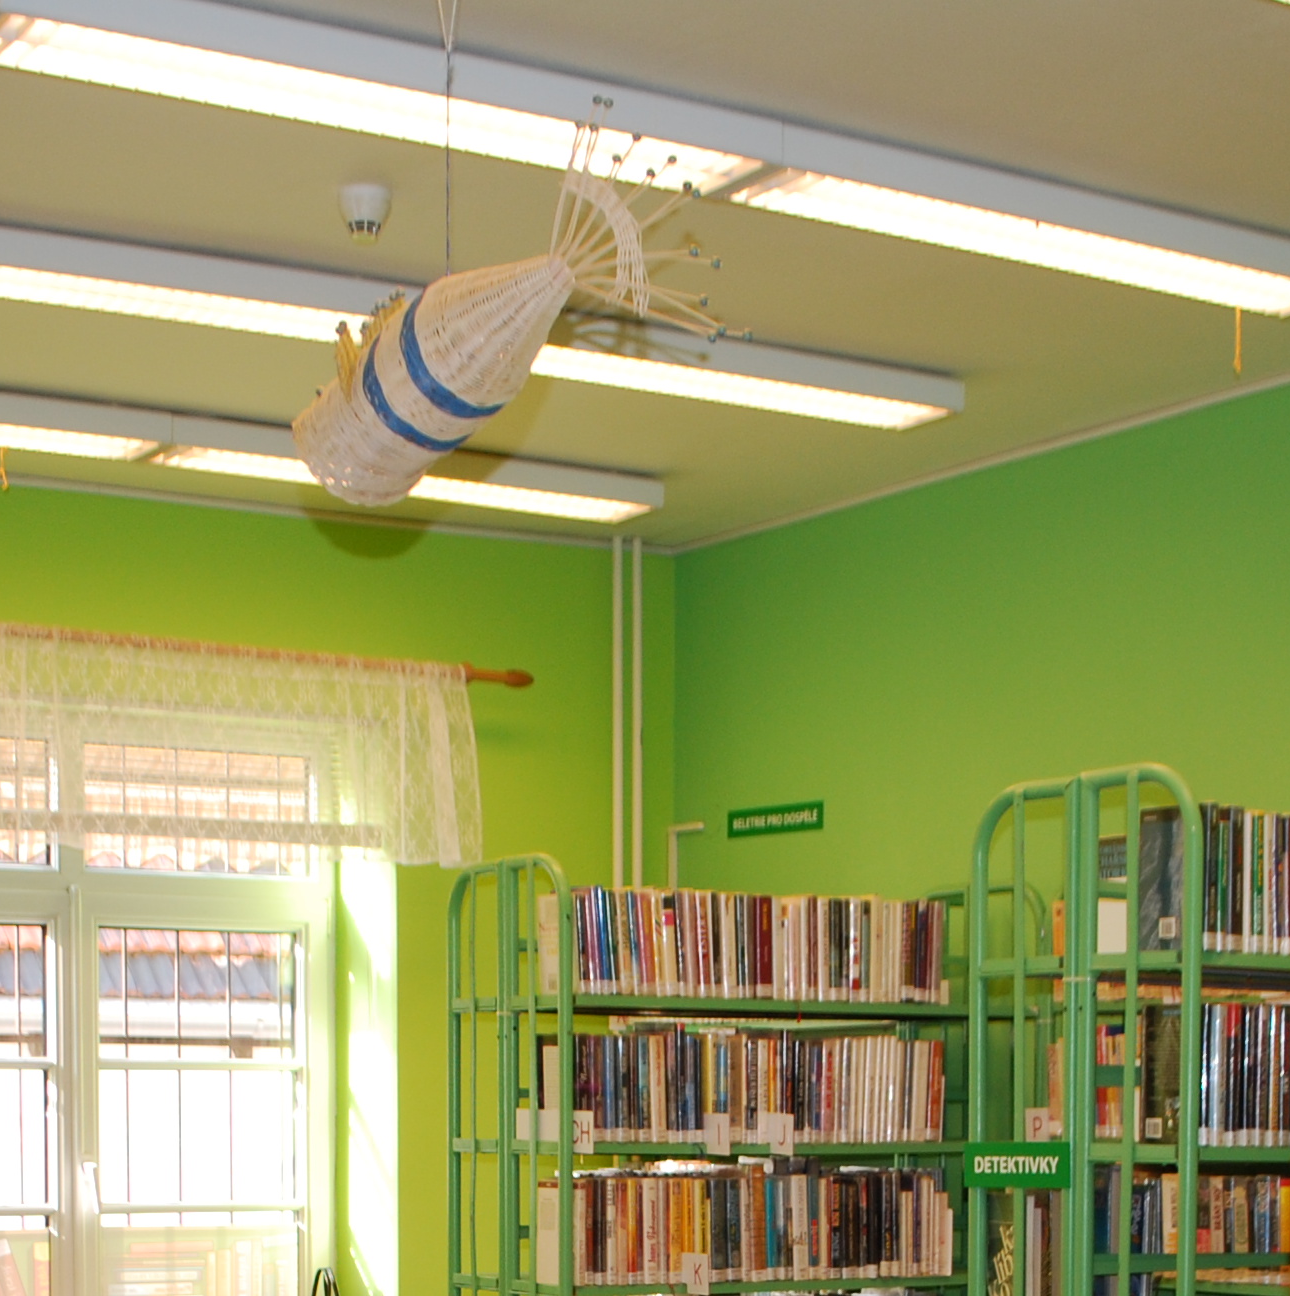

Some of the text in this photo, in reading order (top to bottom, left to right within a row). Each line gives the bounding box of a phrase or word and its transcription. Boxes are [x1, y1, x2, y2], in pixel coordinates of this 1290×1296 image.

[732, 815, 764, 832] BELETRIE
[767, 813, 780, 829] PRO
[974, 1155, 1059, 1174] DETEKTIVKY
